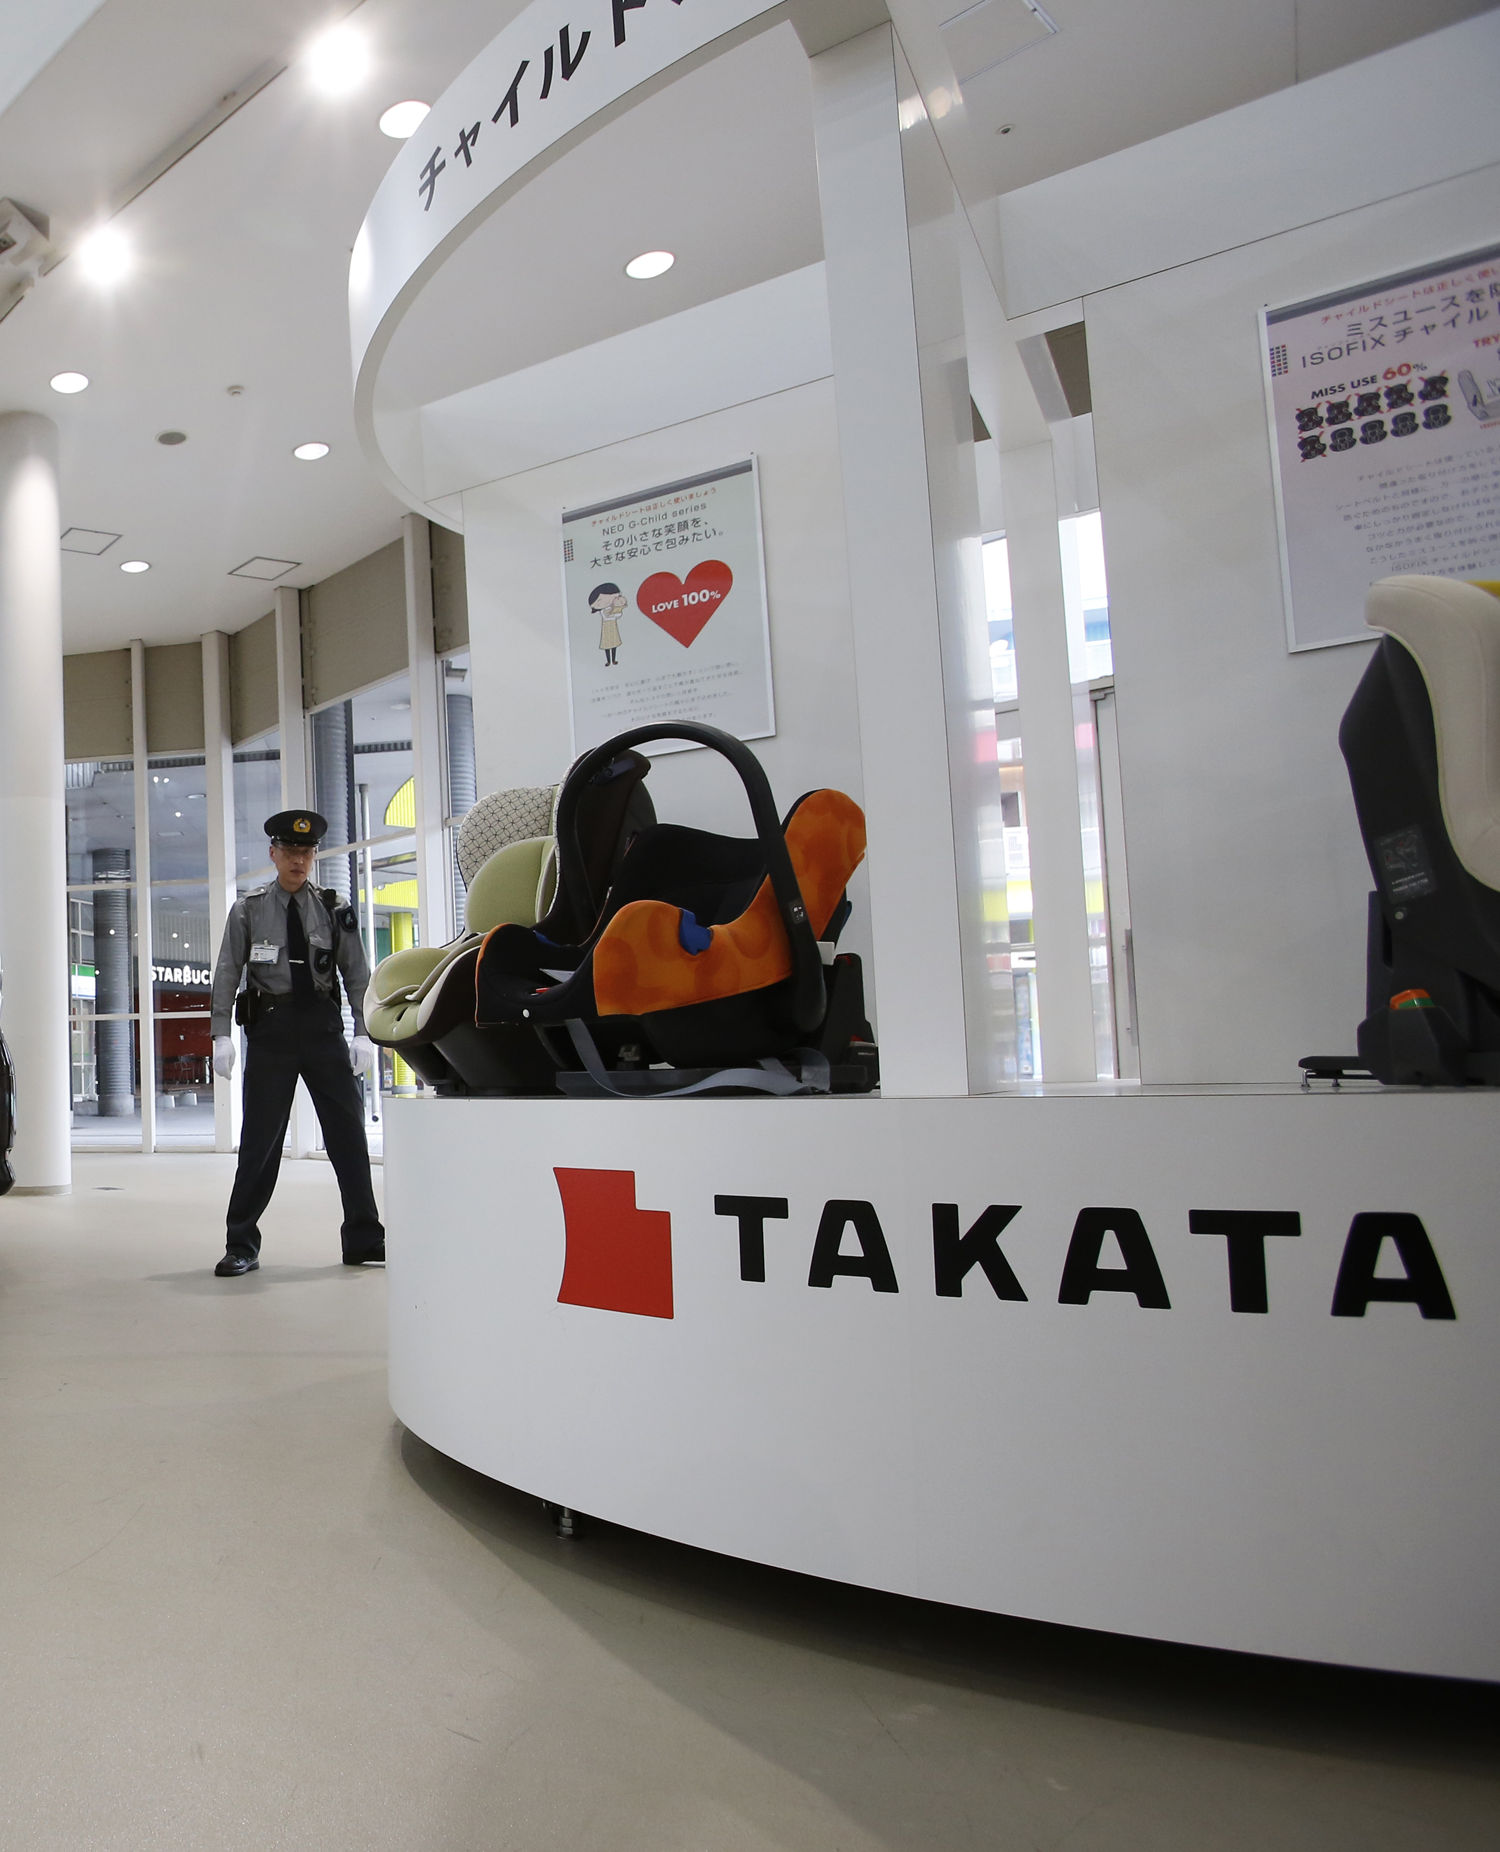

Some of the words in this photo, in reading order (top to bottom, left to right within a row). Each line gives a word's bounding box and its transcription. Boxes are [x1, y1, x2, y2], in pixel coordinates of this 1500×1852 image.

[1302, 333, 1386, 369] ISOFIX
[1394, 301, 1500, 344] チャイル
[1311, 383, 1346, 400] MISS
[1350, 375, 1378, 389] USE
[1382, 362, 1428, 381] 60%
[602, 523, 625, 537] NEO
[628, 512, 668, 530] G-Child
[671, 502, 707, 518] series
[602, 517, 709, 551] その小さな笑顔を、
[590, 528, 724, 569] 大きな安心で包みたい。
[651, 599, 680, 614] LOVE
[681, 588, 722, 607] 100%
[151, 965, 213, 986] STARBUC
[714, 1194, 1457, 1321] TAKATA
